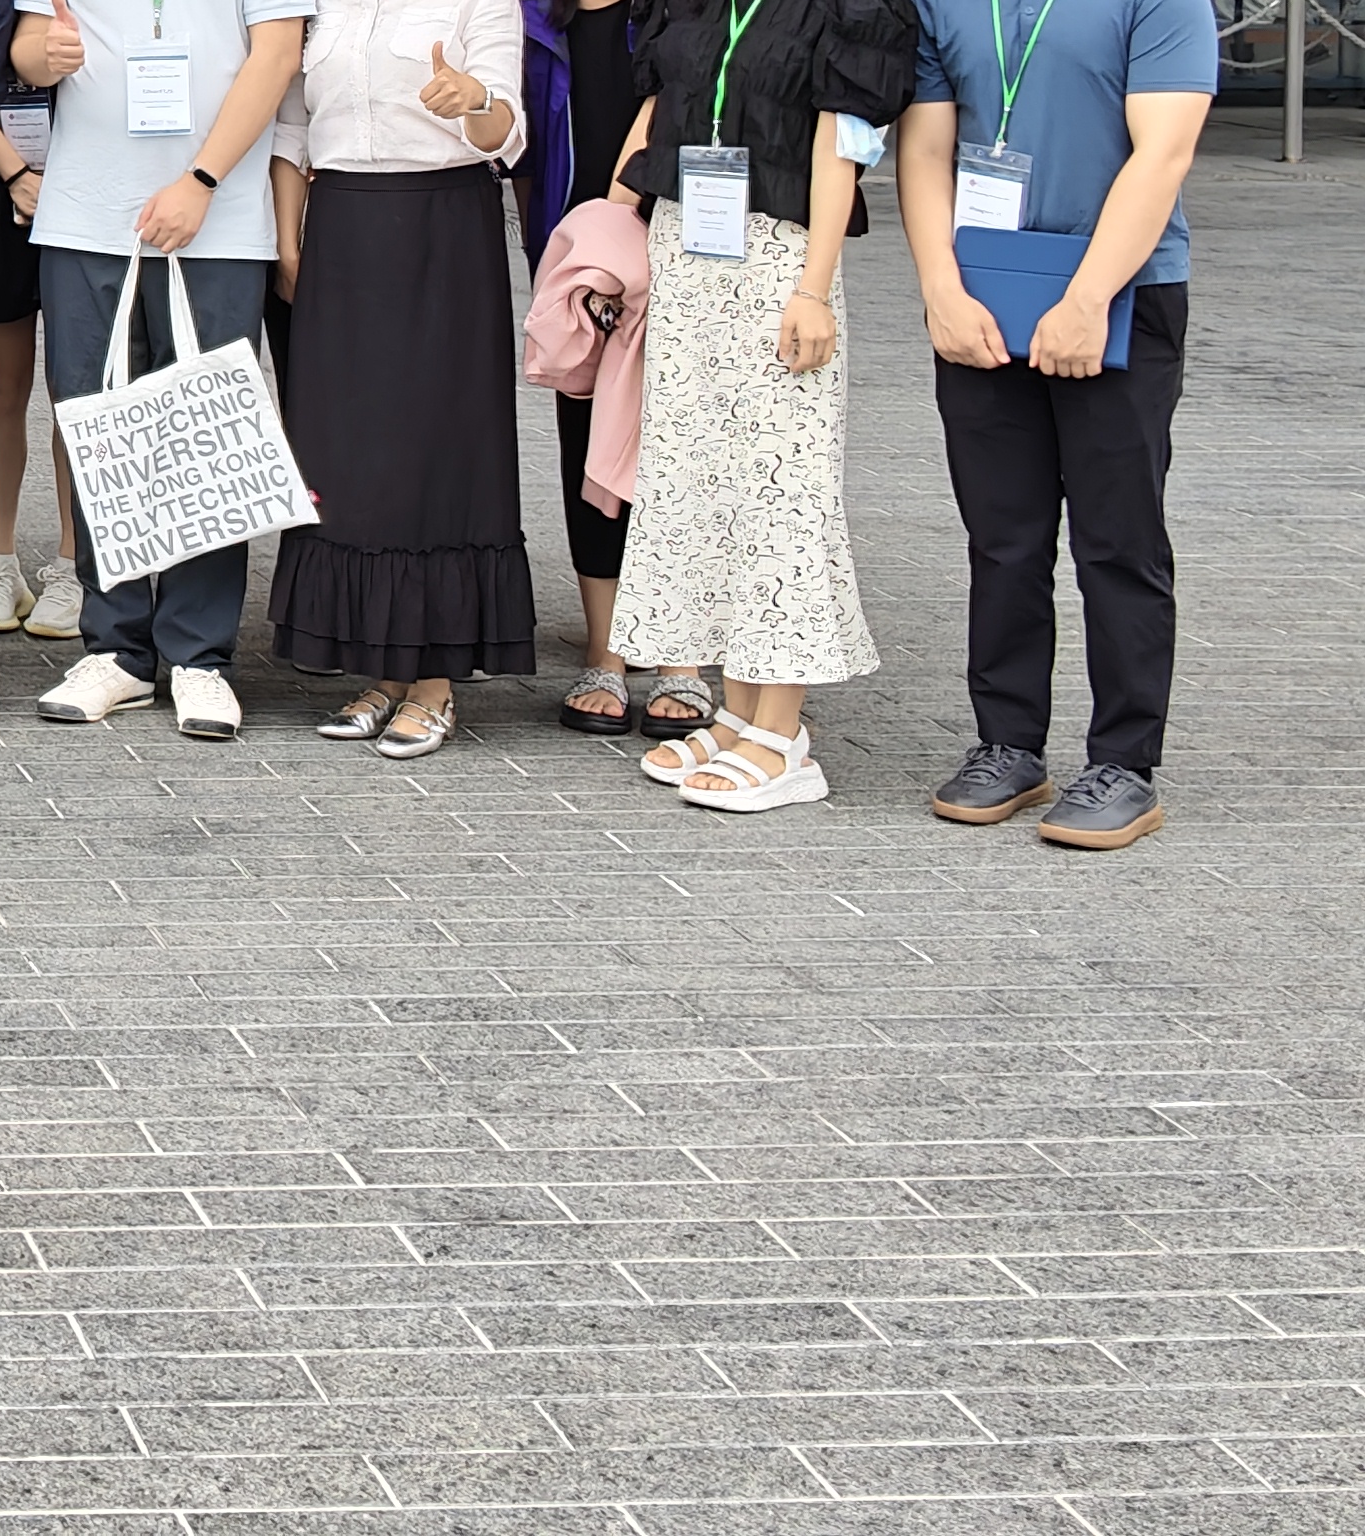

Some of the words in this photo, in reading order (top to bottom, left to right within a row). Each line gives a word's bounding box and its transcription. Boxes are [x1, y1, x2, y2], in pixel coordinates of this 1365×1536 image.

[69, 414, 109, 441] THE
[112, 390, 175, 431] HONG
[179, 368, 251, 401] KONG
[75, 387, 257, 468] PLYTECHNIC
[82, 411, 264, 497] UNIVERSITY
[90, 495, 133, 521] THE
[136, 467, 203, 508] HONG
[207, 441, 280, 479] KONG
[93, 464, 289, 548] POLYTECHNIC
[101, 489, 297, 577] UNIVERSITY
